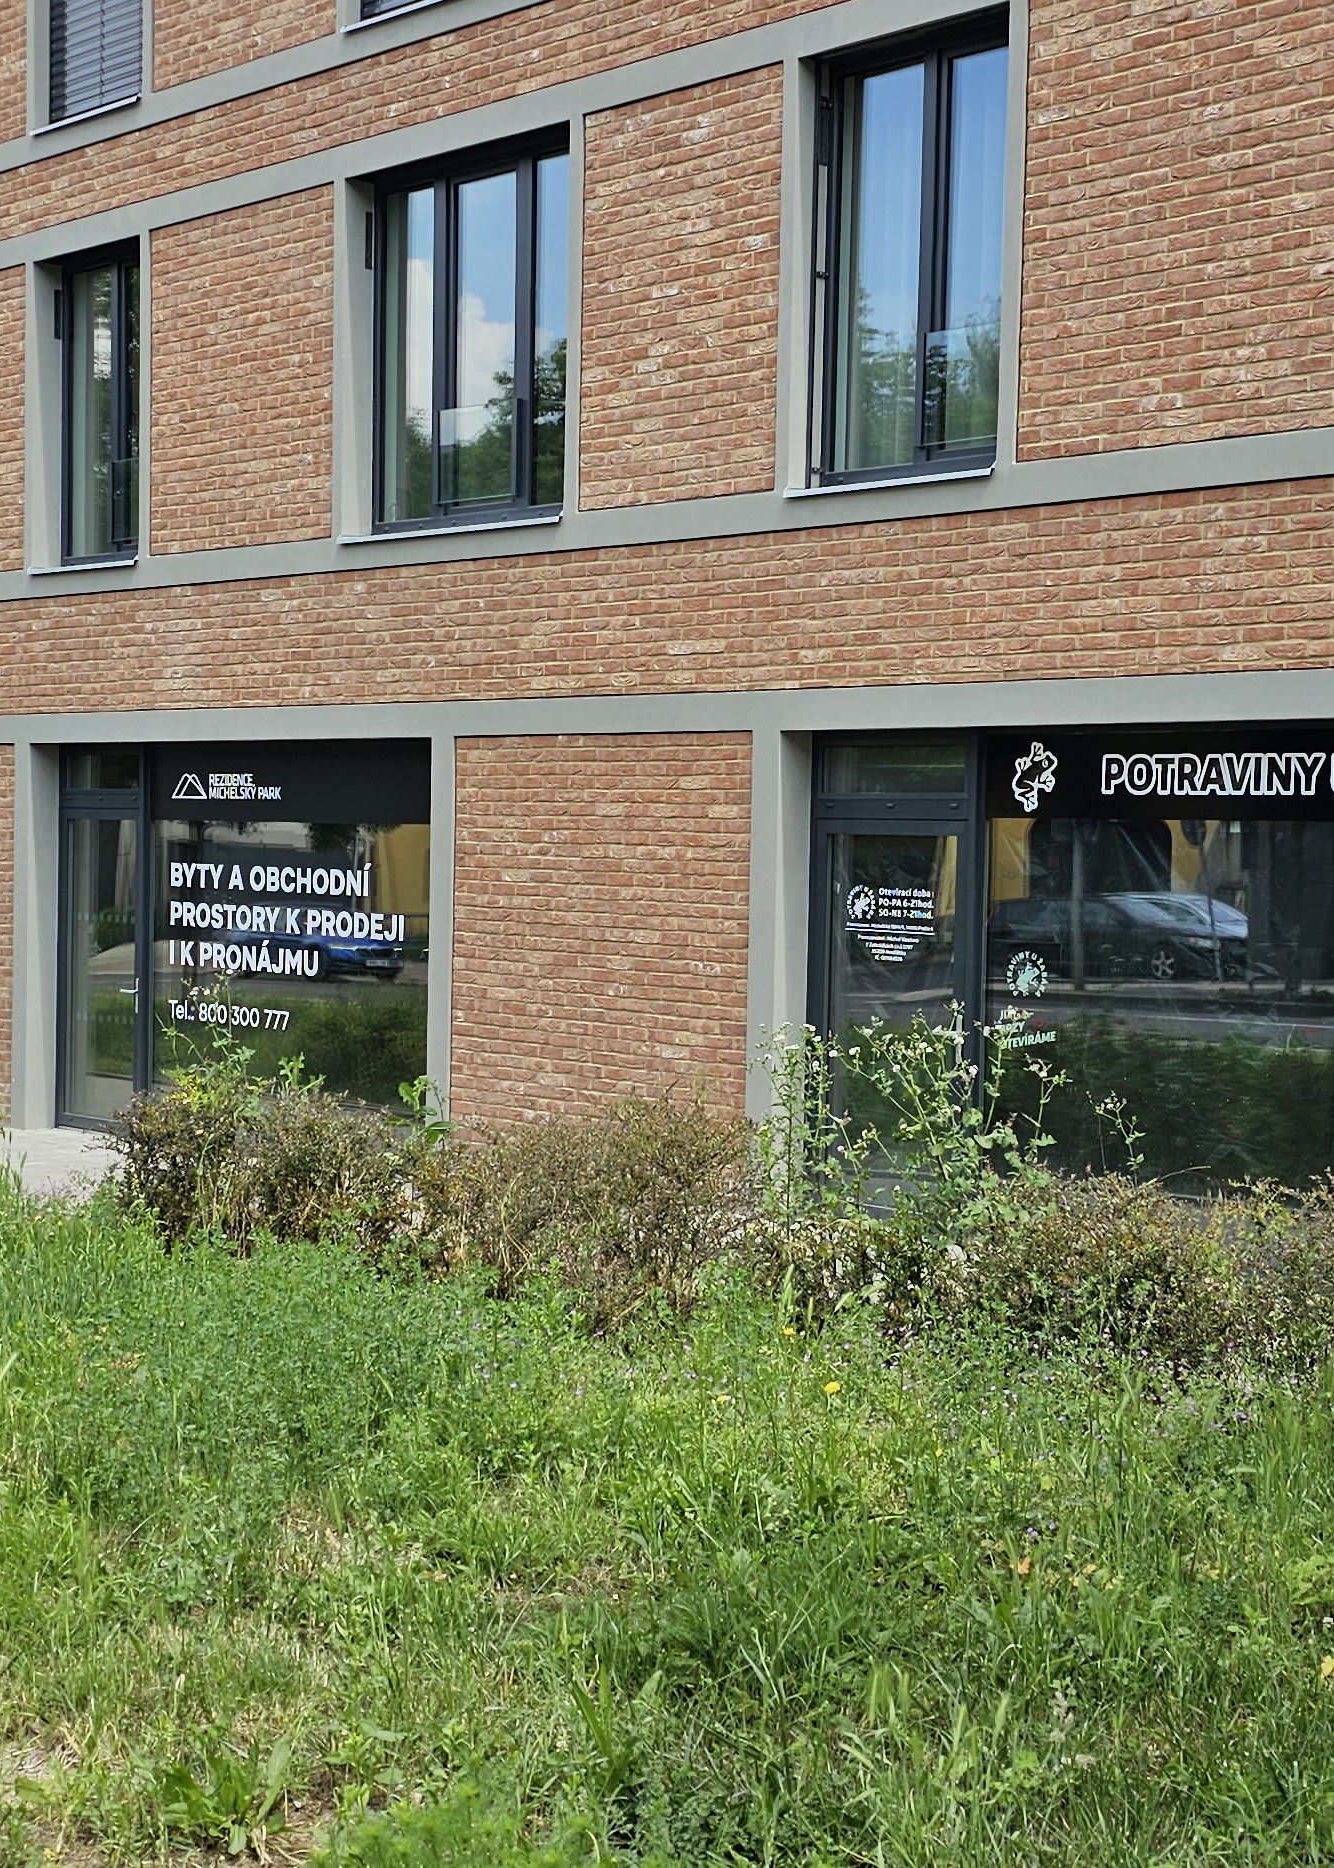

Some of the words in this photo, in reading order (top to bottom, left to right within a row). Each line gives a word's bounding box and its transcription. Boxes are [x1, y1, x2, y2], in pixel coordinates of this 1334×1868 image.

[209, 773, 254, 787] REZIDENCE
[1101, 752, 1326, 797] POTRAVINY
[209, 784, 256, 800] MICHELSKÝ
[258, 786, 282, 800] PARK
[170, 862, 224, 889] BYTY
[228, 865, 244, 891] A
[249, 863, 372, 897] OBCHODNÍ
[878, 898, 902, 907] PO-PA
[878, 908, 902, 918] SO-NE
[170, 901, 281, 933] PROSTORY
[286, 908, 300, 935] K
[306, 909, 405, 942] PRODEJI
[169, 939, 175, 965] I
[180, 940, 195, 967] K
[199, 940, 318, 977] PRONÁJMU
[1006, 951, 1031, 997] POTRAVINY
[199, 1002, 227, 1024] 800
[231, 1005, 260, 1028] 300
[263, 1008, 290, 1031] 777
